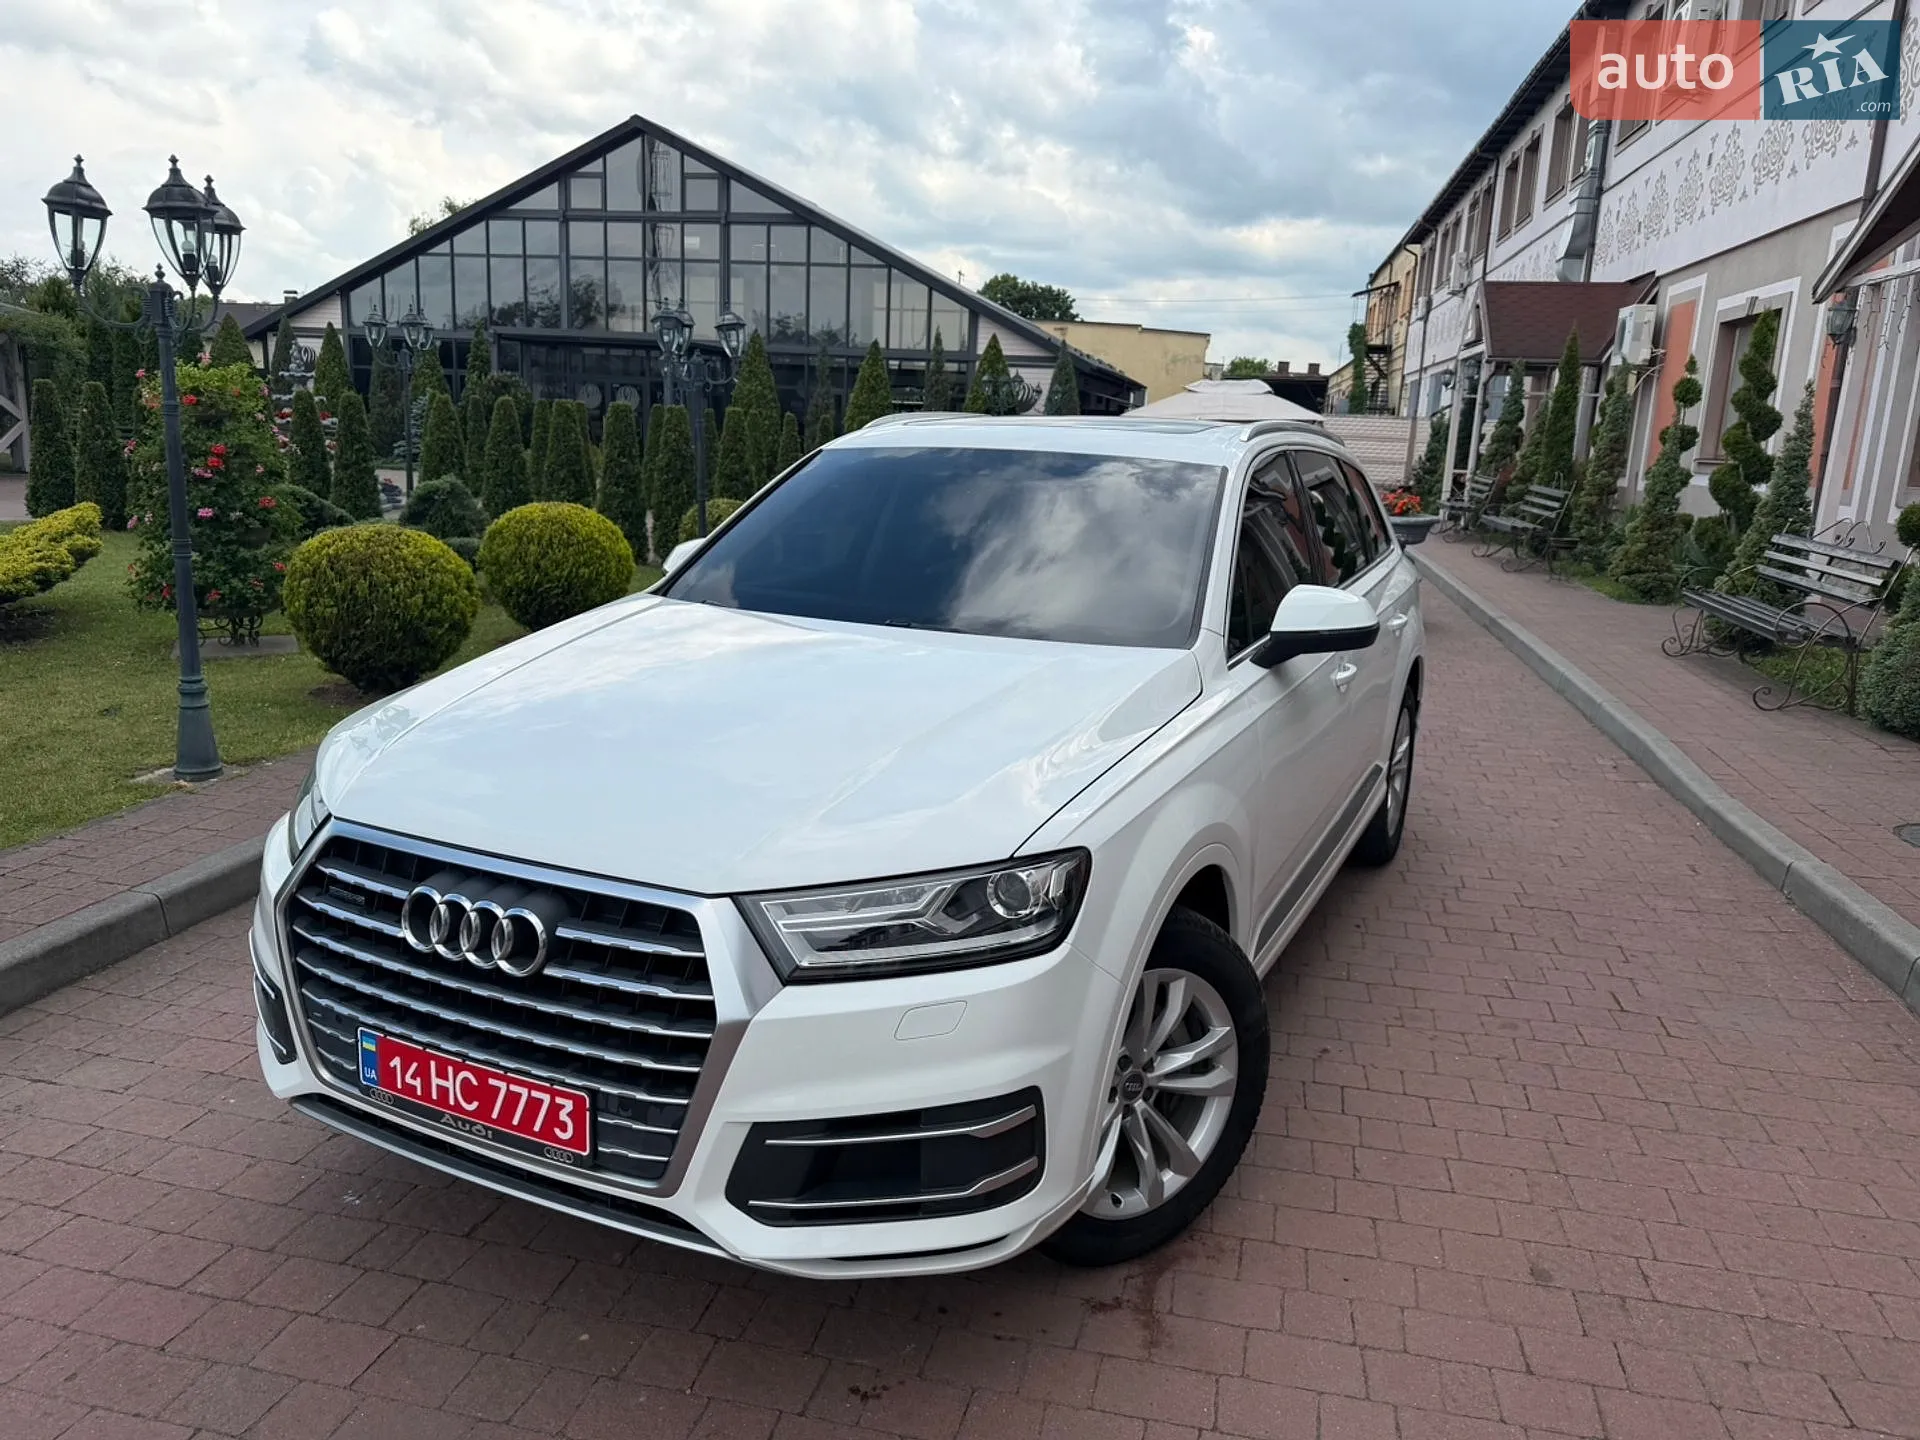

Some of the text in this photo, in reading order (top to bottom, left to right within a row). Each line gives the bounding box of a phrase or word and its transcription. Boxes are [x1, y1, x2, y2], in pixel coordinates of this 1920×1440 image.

[364, 1067, 378, 1081] UA
[389, 1056, 422, 1096] 14
[488, 1078, 574, 1140] 7773
[440, 1114, 493, 1140] Audi
